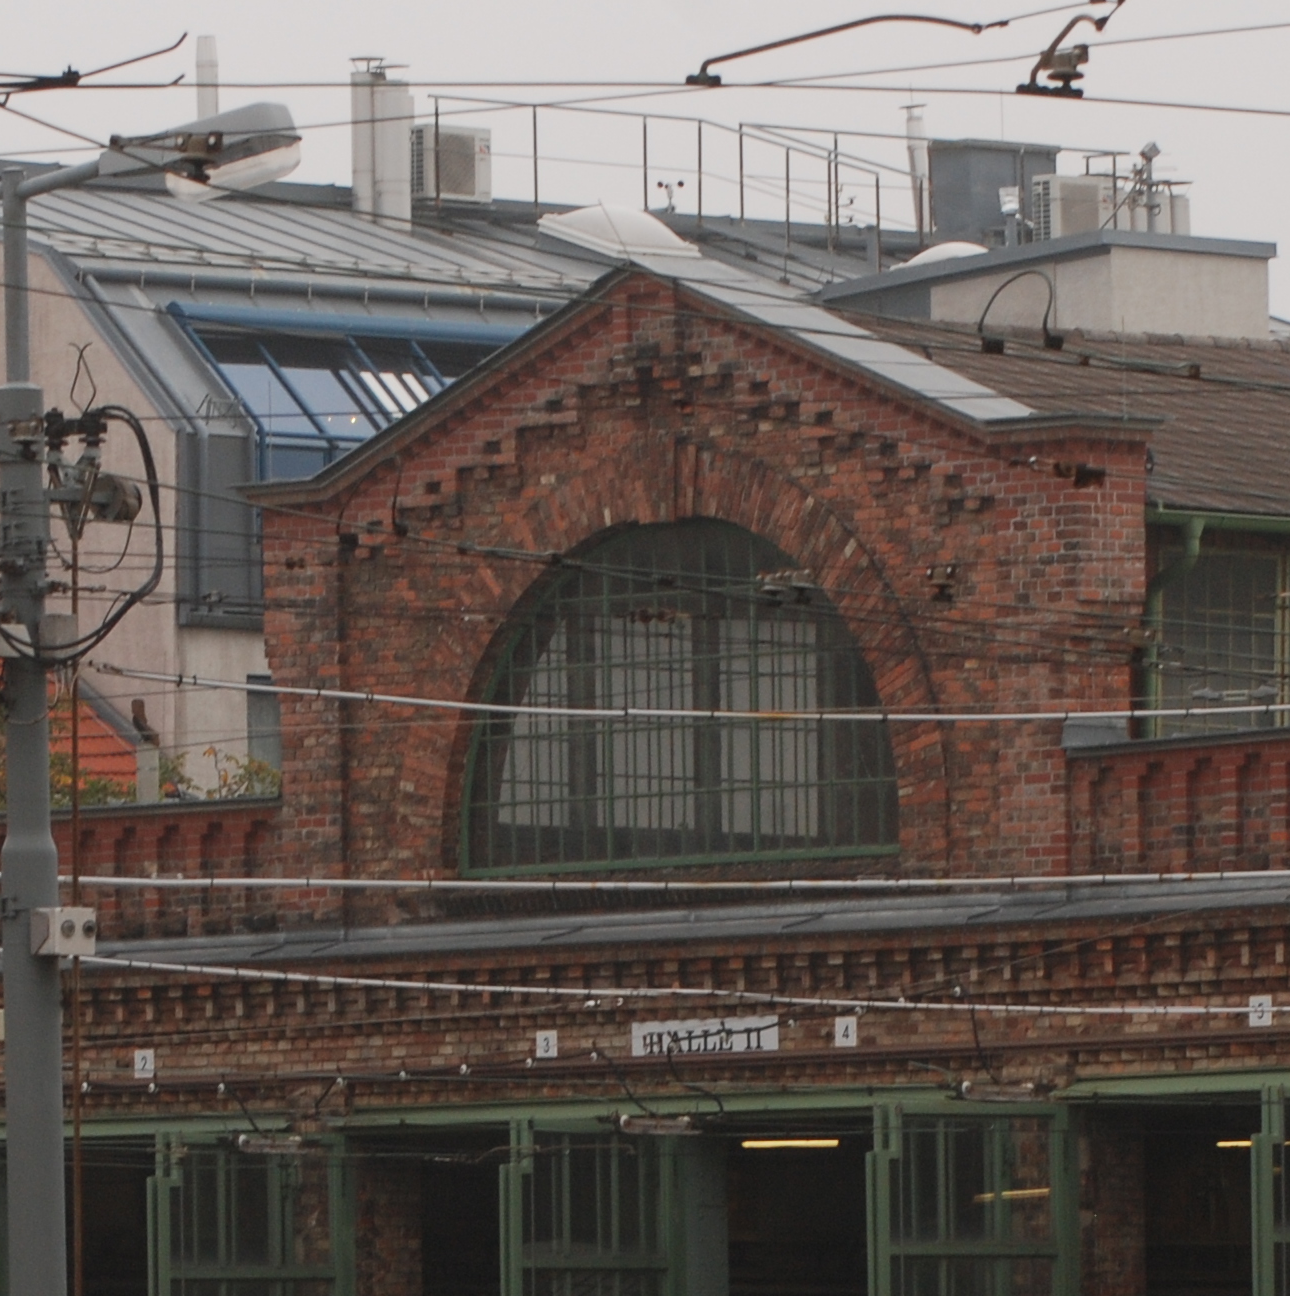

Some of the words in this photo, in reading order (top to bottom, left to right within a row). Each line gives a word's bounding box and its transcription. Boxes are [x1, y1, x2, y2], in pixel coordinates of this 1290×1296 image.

[647, 1027, 734, 1055] HALLE
[841, 1024, 850, 1040] 4
[543, 1036, 550, 1054] 3
